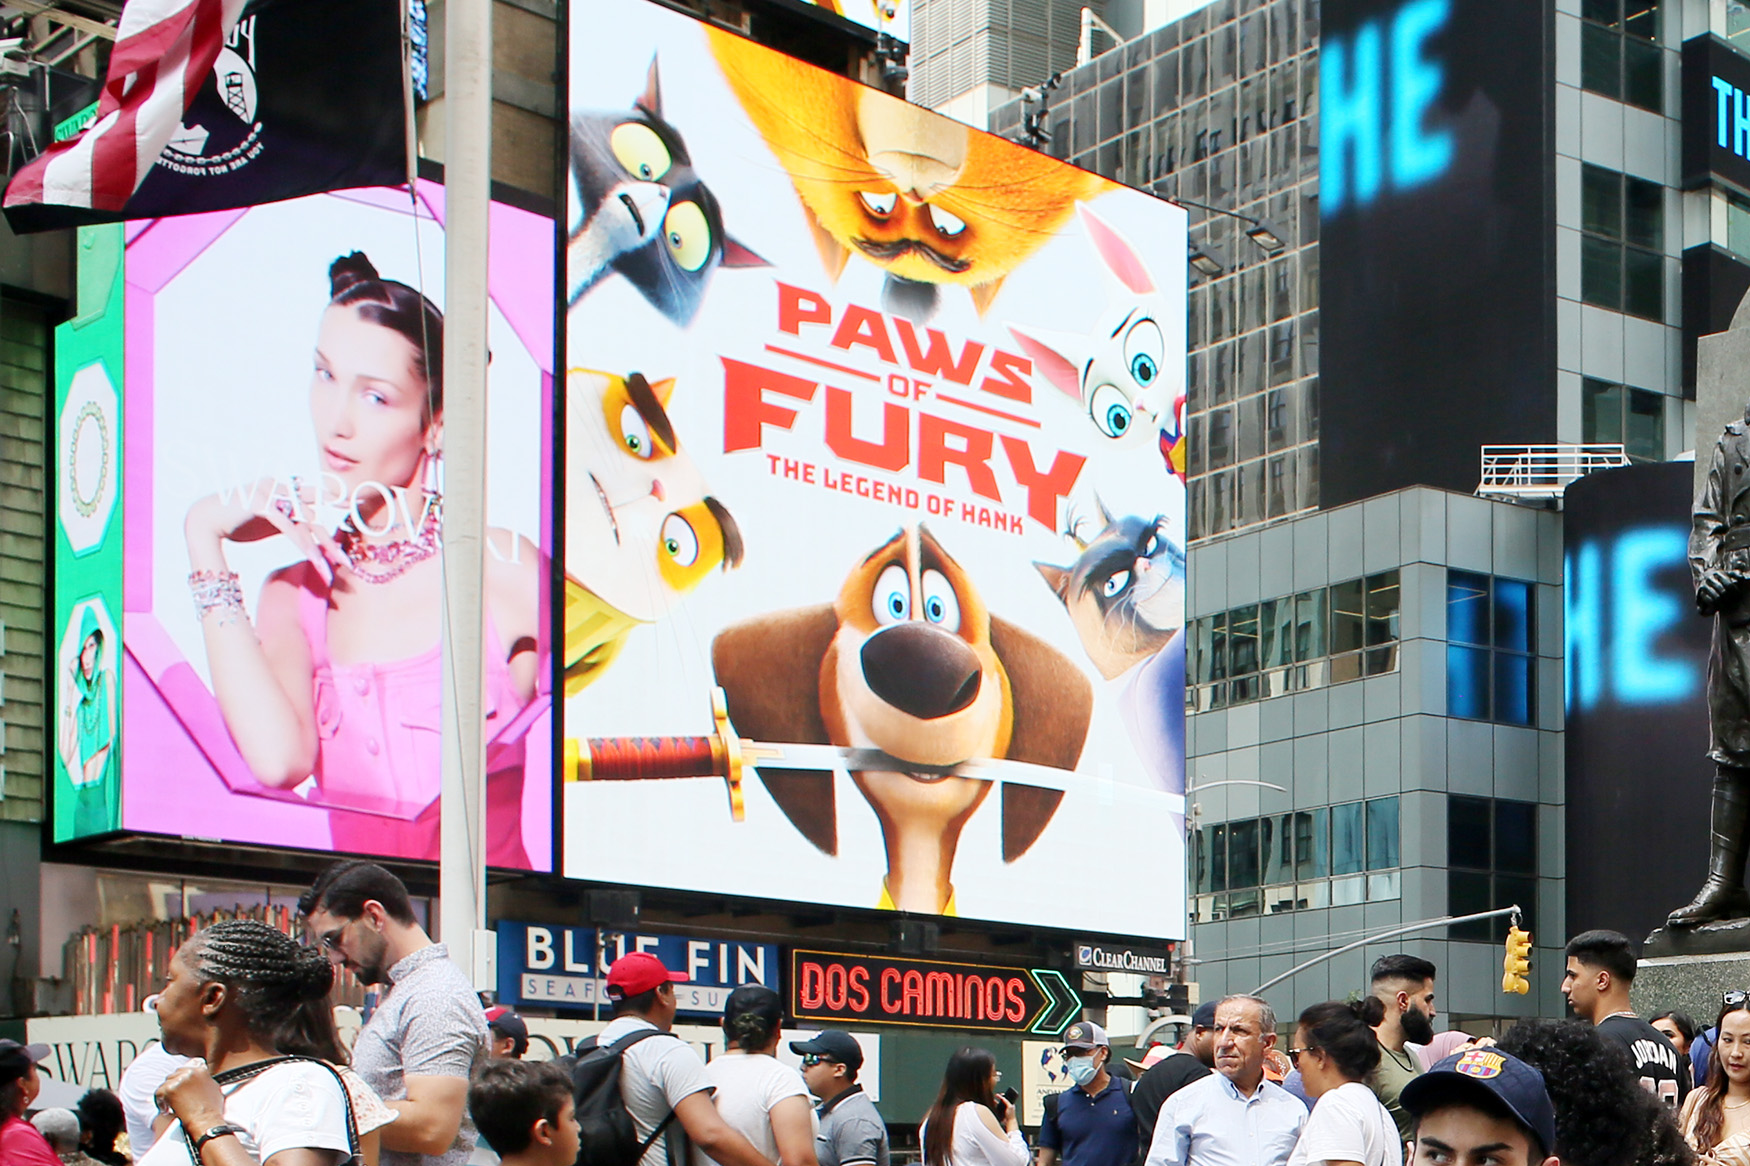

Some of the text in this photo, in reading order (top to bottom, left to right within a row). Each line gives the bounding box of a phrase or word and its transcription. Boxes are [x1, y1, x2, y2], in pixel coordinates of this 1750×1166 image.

[773, 278, 1033, 406] PAWS
[887, 373, 935, 402] OF
[718, 354, 1088, 535] FURY
[767, 453, 1025, 537] THE LEGEND OF HANK
[687, 940, 766, 986] FIN
[801, 962, 1026, 1023] DOS CAMINOS
[1631, 1039, 1677, 1075] JORDAN
